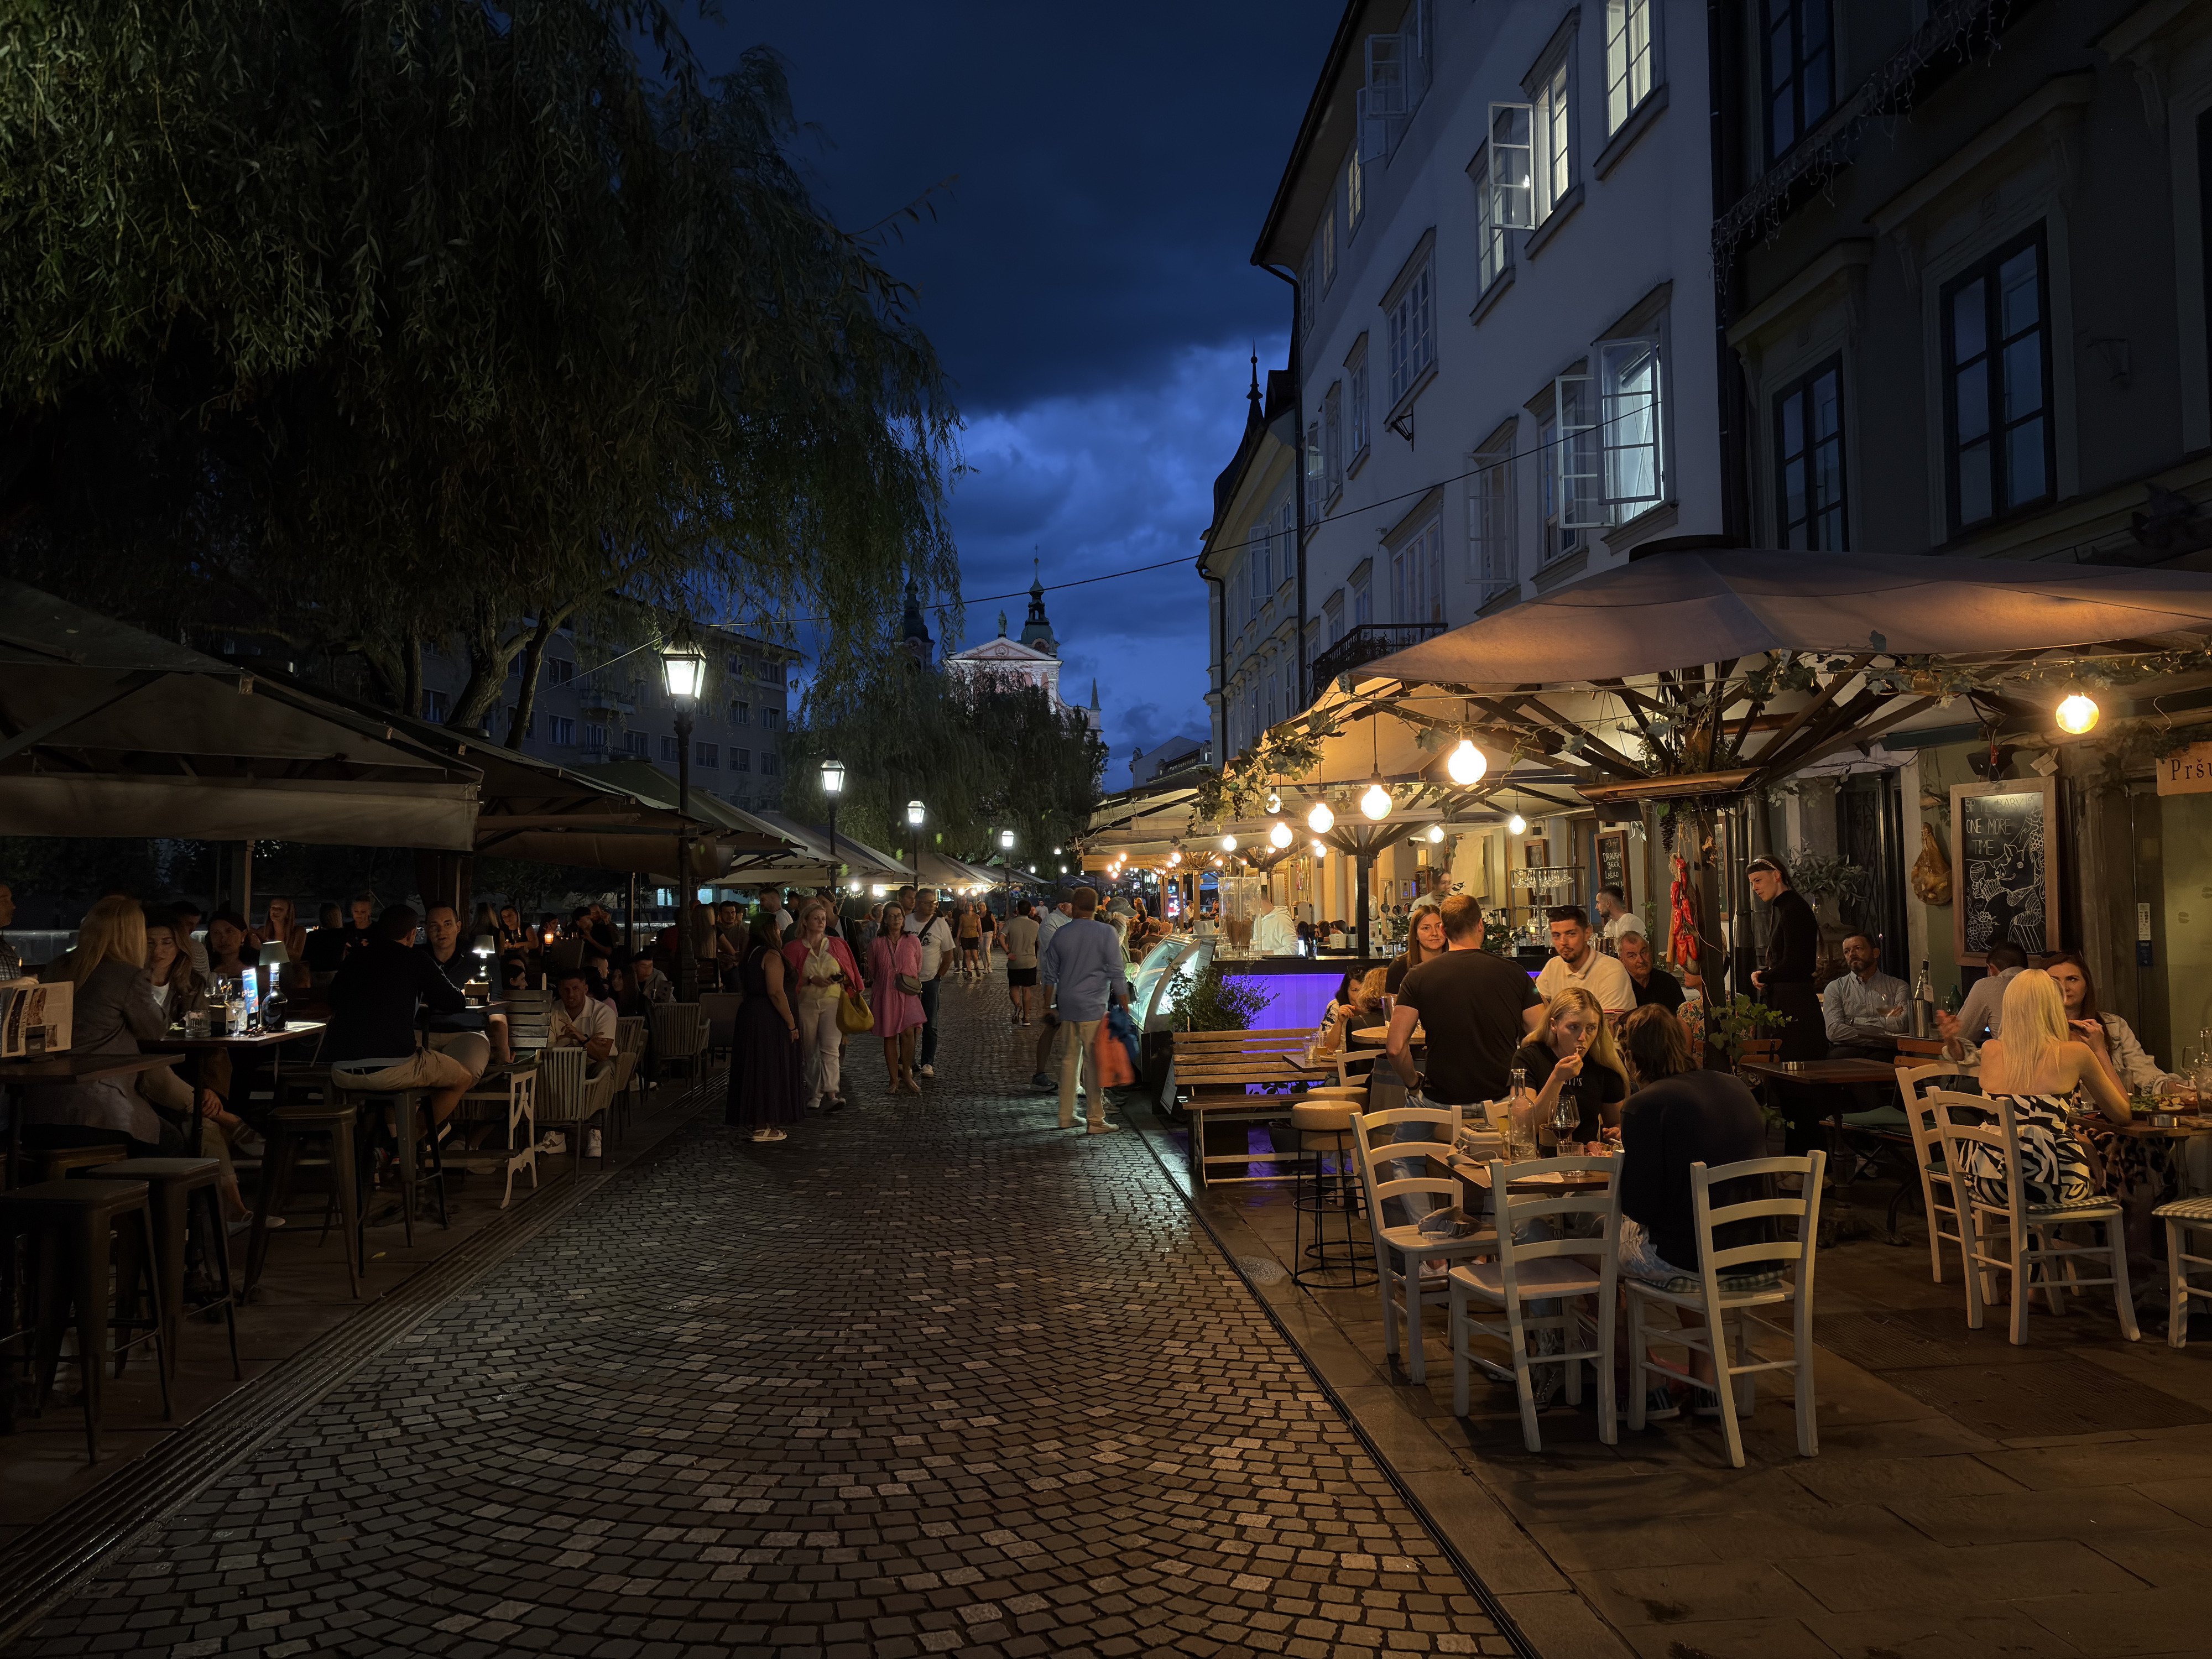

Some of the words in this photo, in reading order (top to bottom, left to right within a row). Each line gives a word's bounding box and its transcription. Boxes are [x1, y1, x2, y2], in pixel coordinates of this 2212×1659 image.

[1997, 797, 2023, 812] BABY
[1966, 818, 1982, 833] ONE
[1987, 818, 2012, 835] MORE
[1971, 839, 1995, 855] TIME
[1603, 852, 1621, 862] DRAUGH
[1607, 861, 1621, 870] BEER
